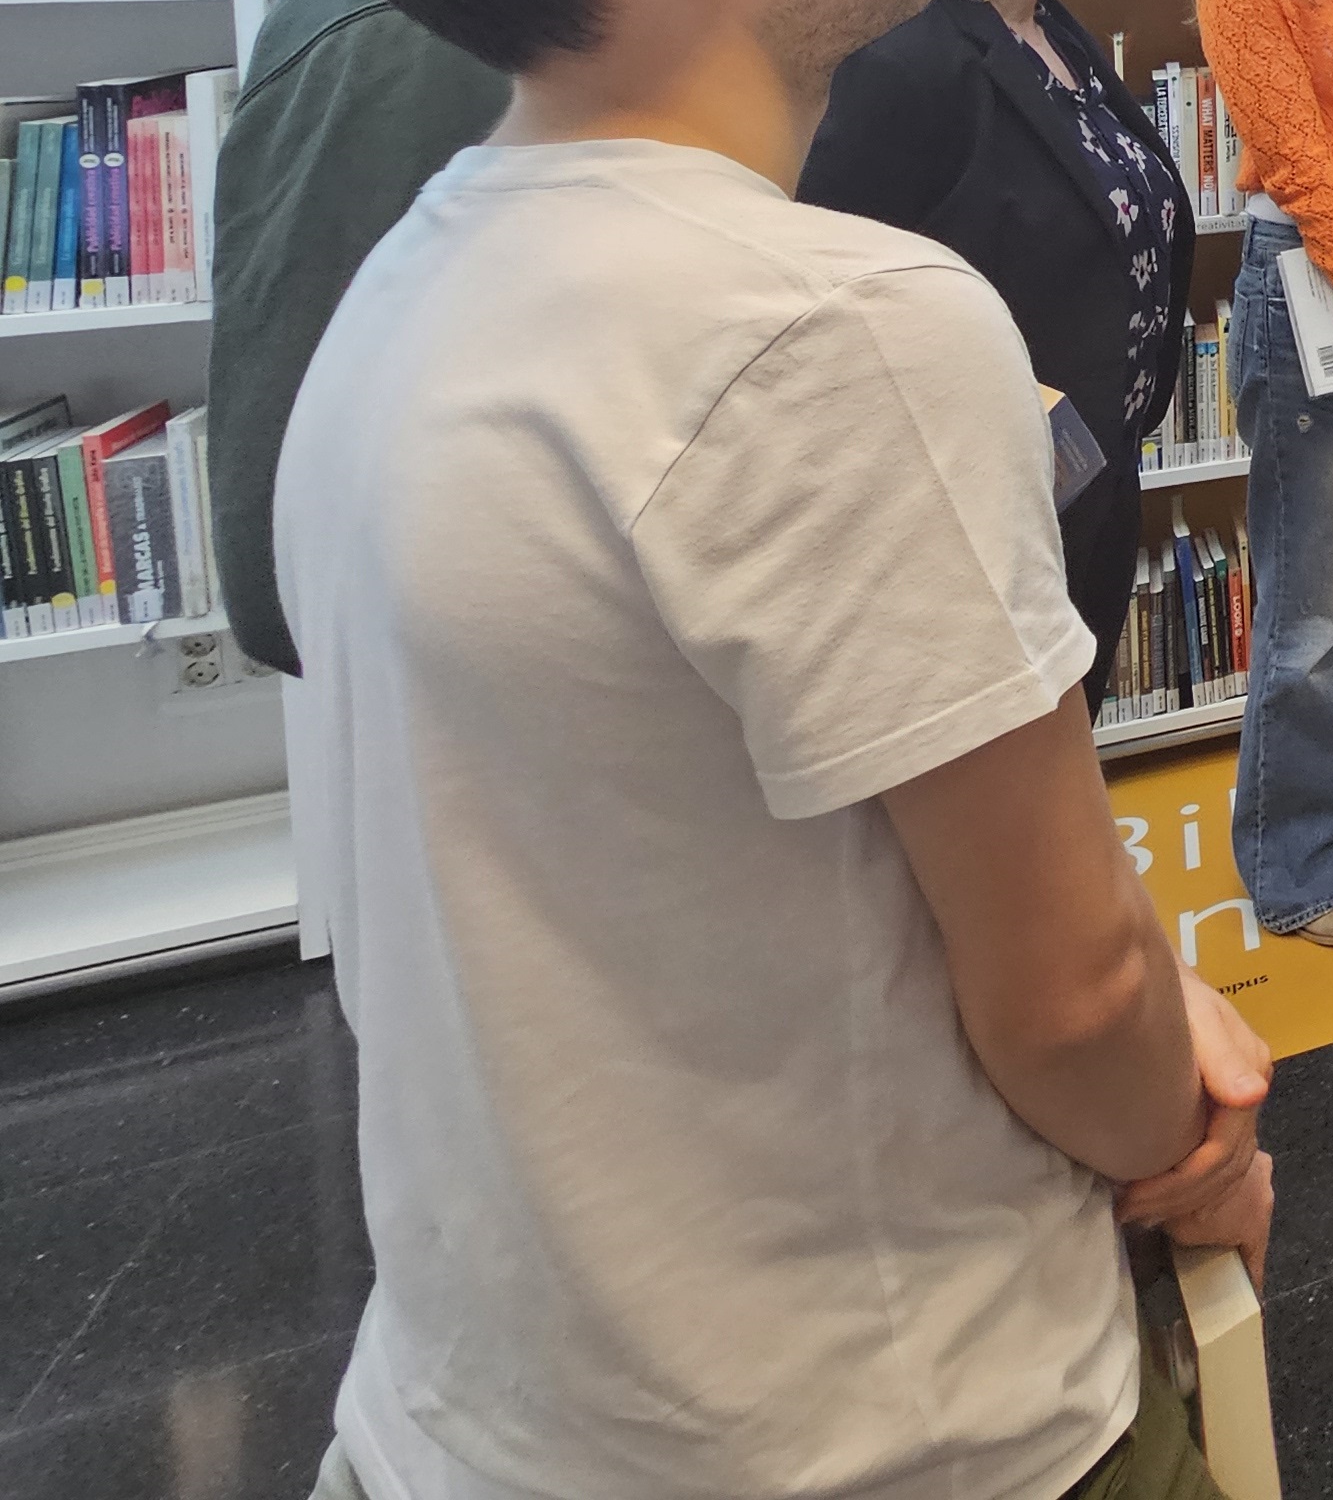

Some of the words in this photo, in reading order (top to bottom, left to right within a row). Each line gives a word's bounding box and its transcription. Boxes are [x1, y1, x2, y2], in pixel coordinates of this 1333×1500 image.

[1201, 98, 1213, 127] WHAT
[1203, 129, 1214, 172] MATTERS
[1197, 220, 1247, 231] reativitat
